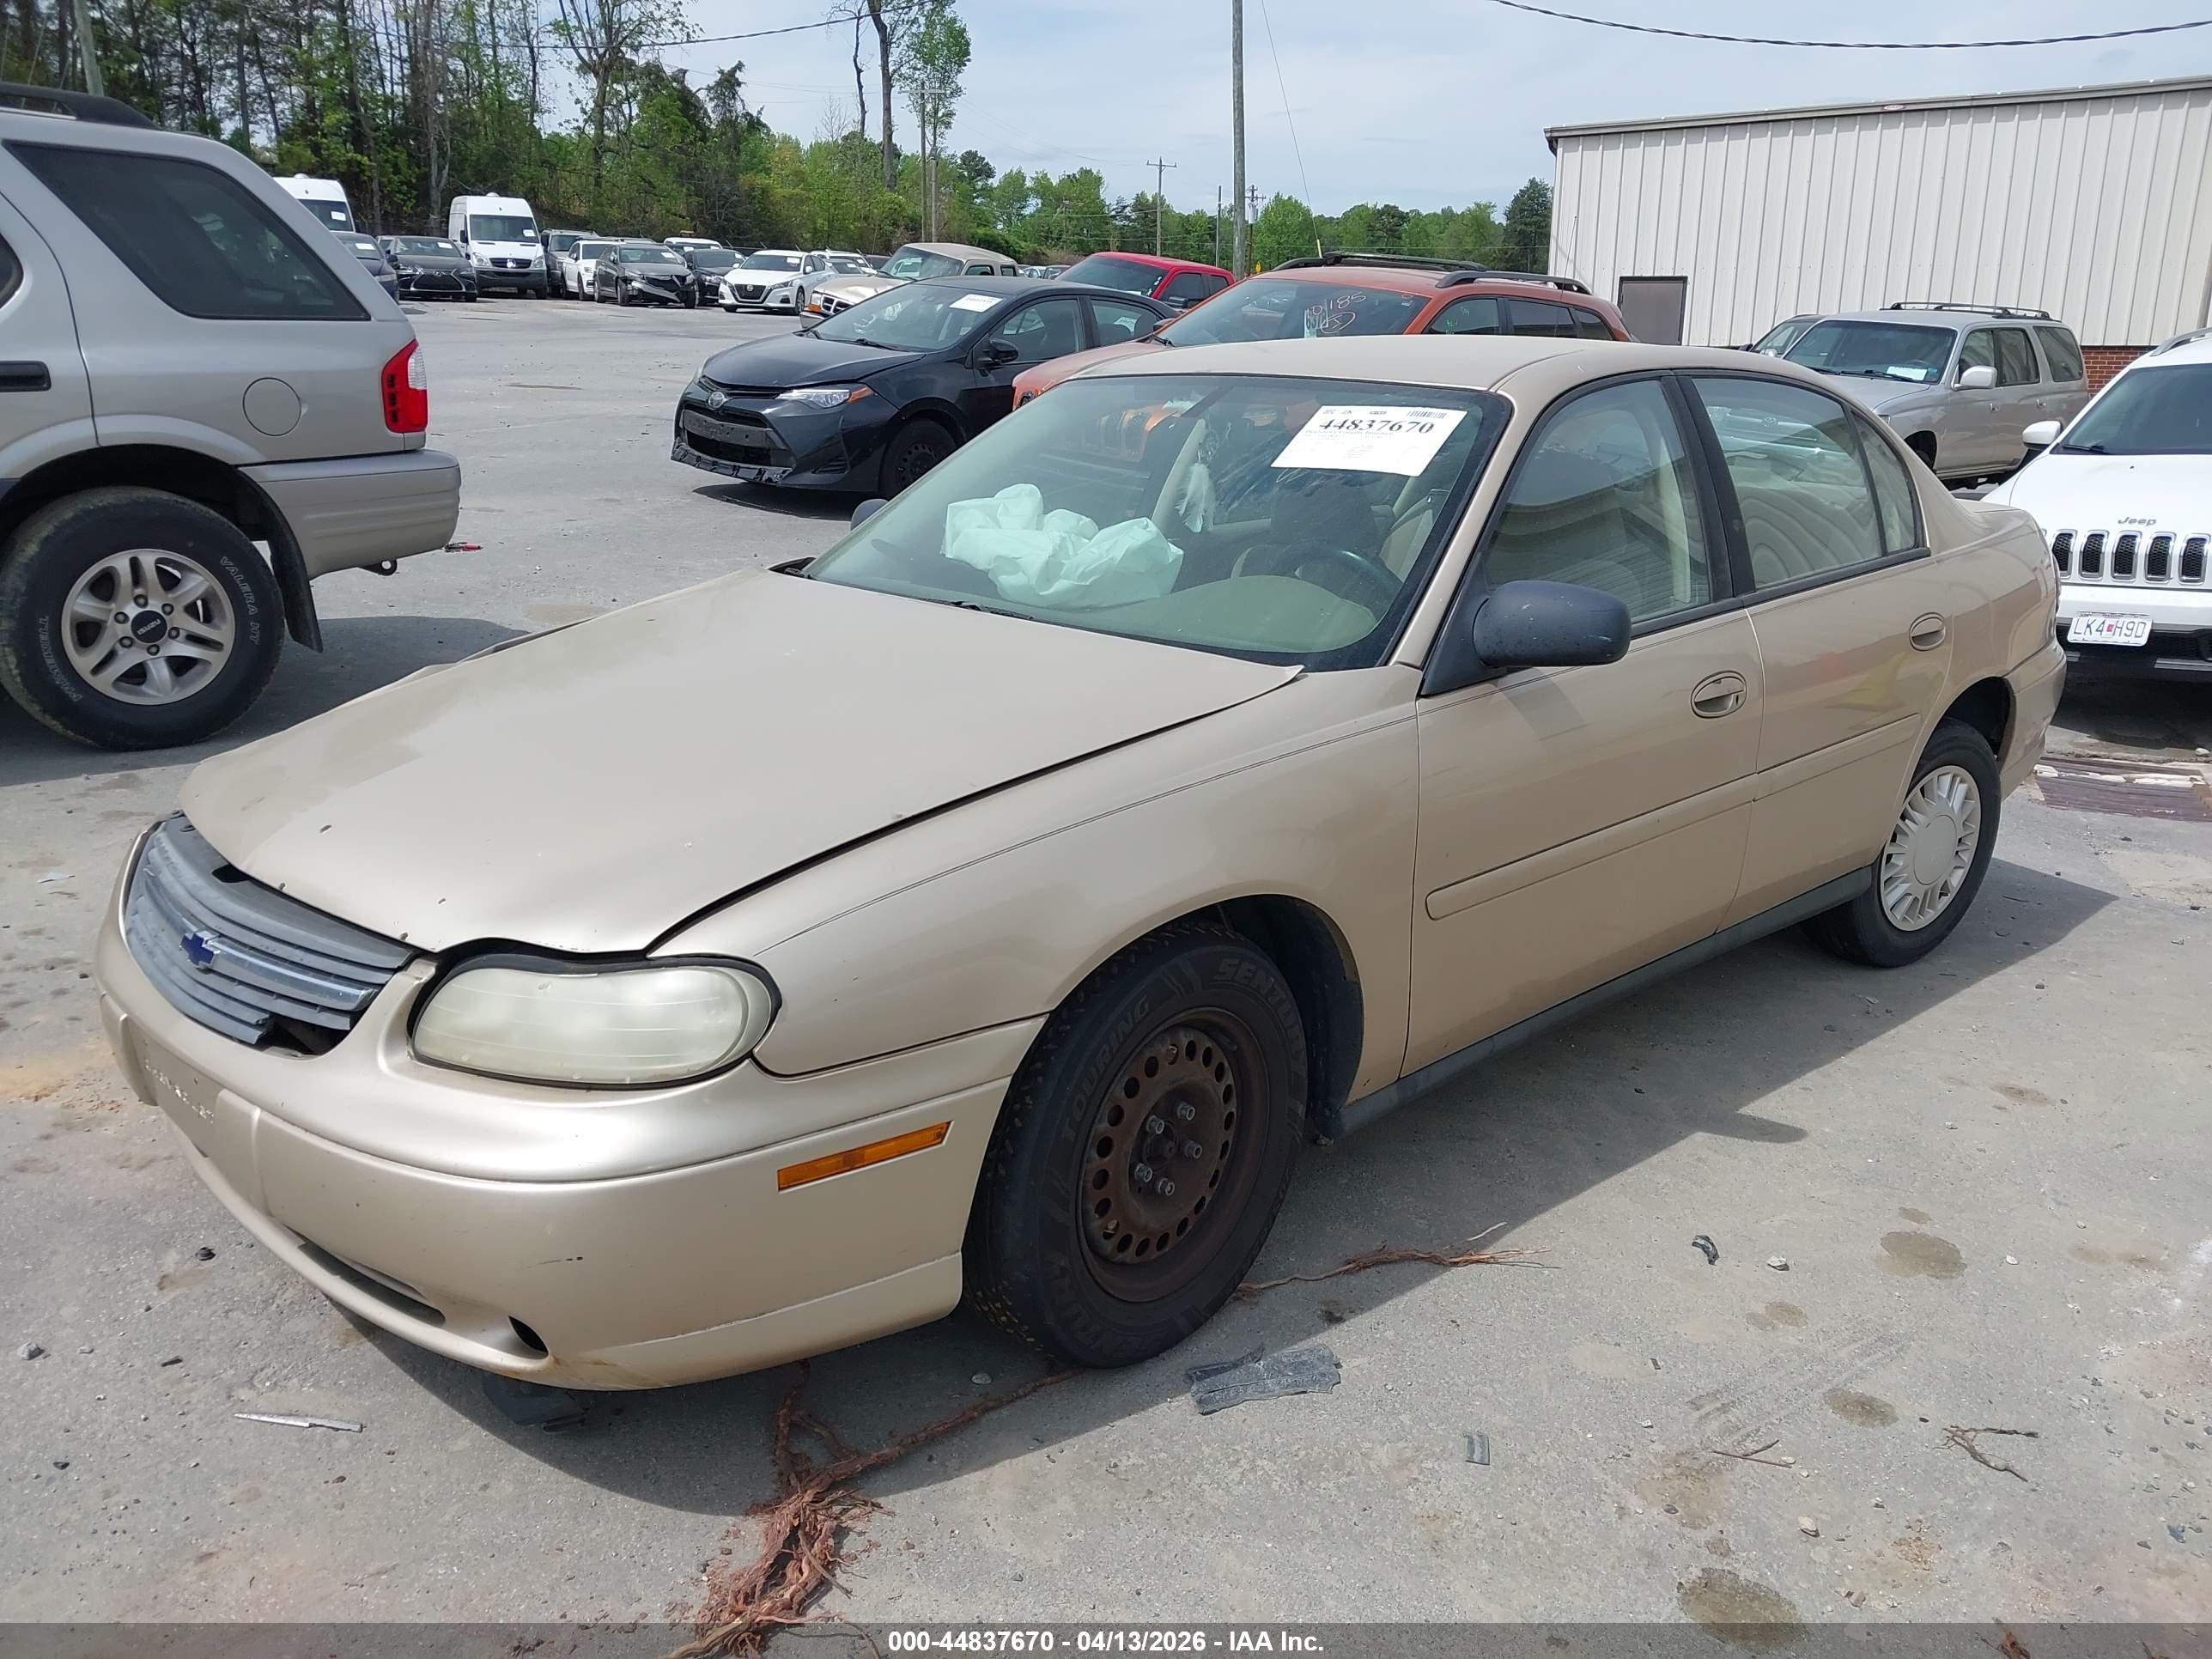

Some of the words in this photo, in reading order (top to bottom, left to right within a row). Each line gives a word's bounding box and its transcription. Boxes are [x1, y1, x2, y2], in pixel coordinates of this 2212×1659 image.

[1319, 418, 1435, 434] 44837670
[2118, 517, 2157, 526] Jeep
[220, 556, 258, 616] VALERA
[249, 621, 261, 646] HT
[137, 618, 161, 635] ISUZU
[1062, 994, 1150, 1140] TOURING
